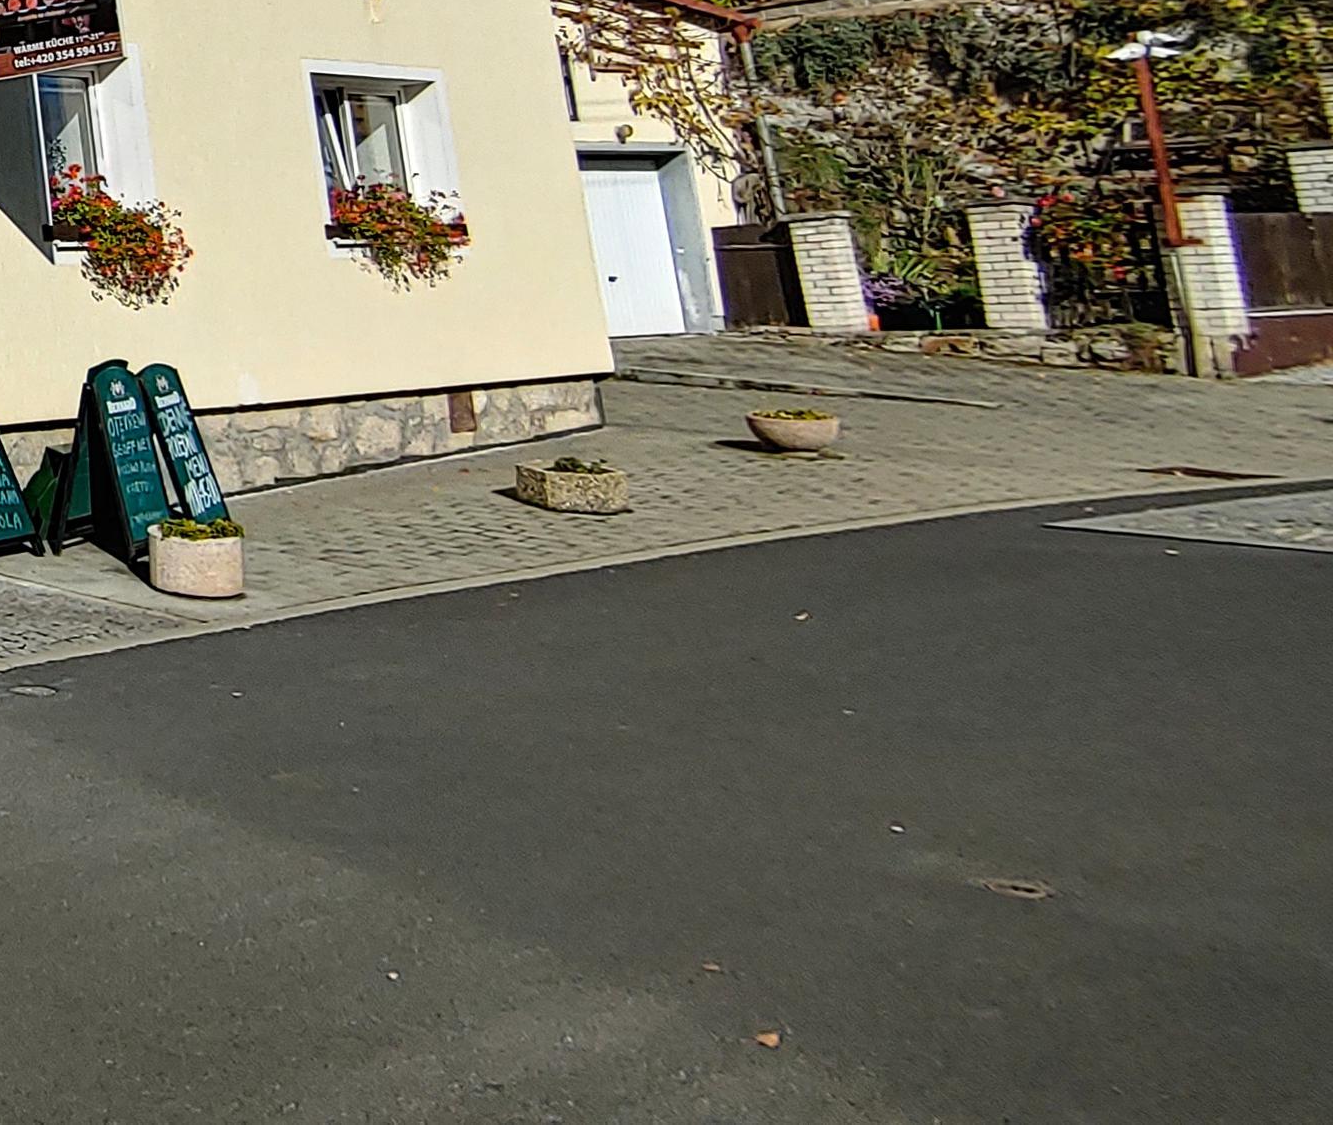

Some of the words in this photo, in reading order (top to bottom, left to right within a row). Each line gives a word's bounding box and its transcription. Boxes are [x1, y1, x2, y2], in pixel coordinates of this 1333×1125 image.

[55, 50, 75, 61] 354
[76, 45, 96, 58] 594
[98, 41, 117, 53] 137
